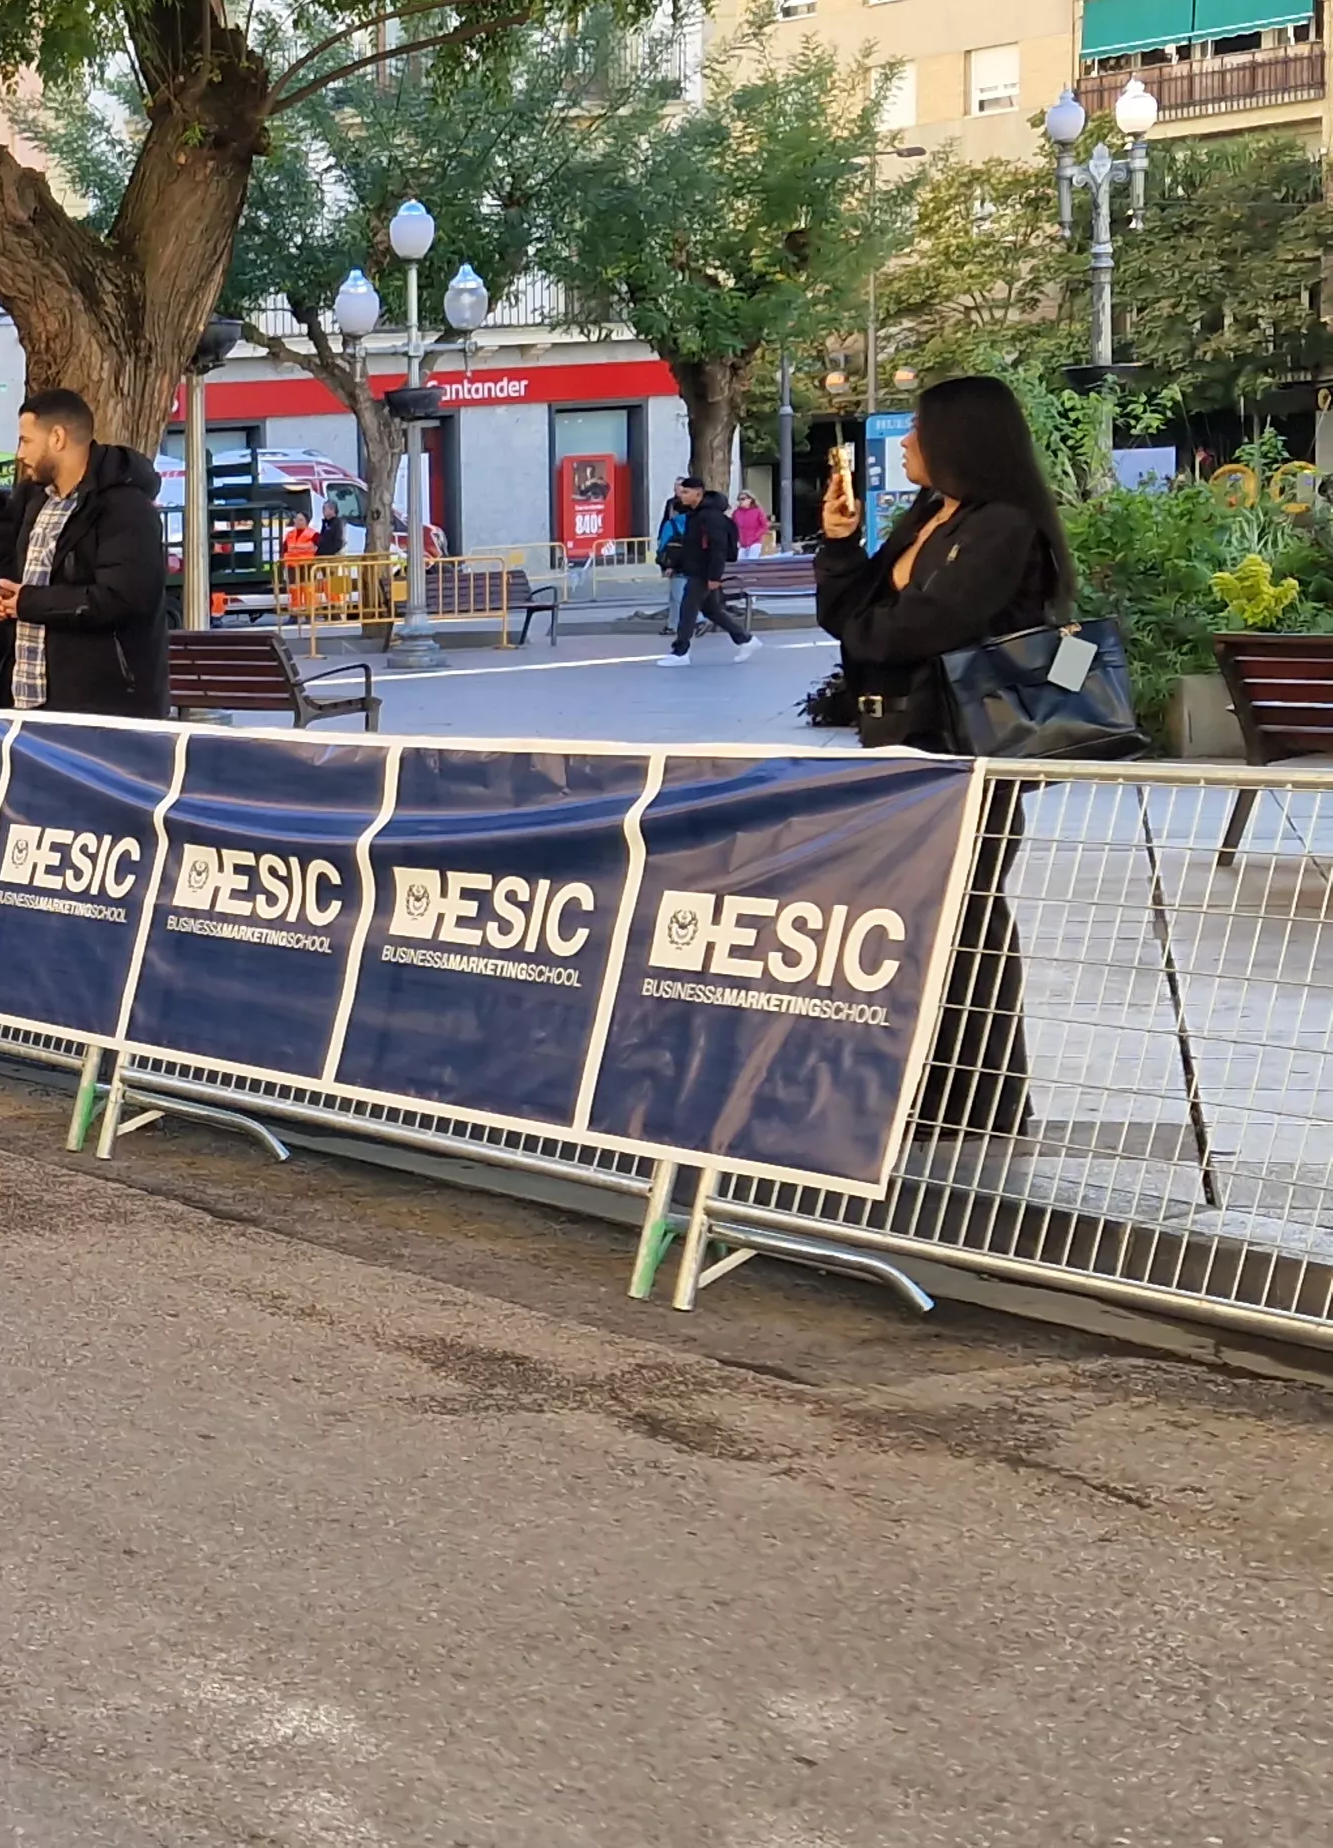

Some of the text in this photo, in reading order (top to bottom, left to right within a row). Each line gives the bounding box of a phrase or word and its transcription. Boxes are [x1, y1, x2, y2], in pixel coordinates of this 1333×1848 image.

[32, 828, 141, 899] ESIC
[216, 851, 342, 927] ESIC
[166, 915, 333, 953] BUSINESS&MARKETINGSCHOOL
[438, 871, 595, 957] ESIC
[709, 895, 906, 992] ESIC
[381, 945, 583, 987] BUSINESS&MARKETINGSCHOOL
[642, 978, 891, 1026] BUSINESS&MARKETINGSCHOOL
